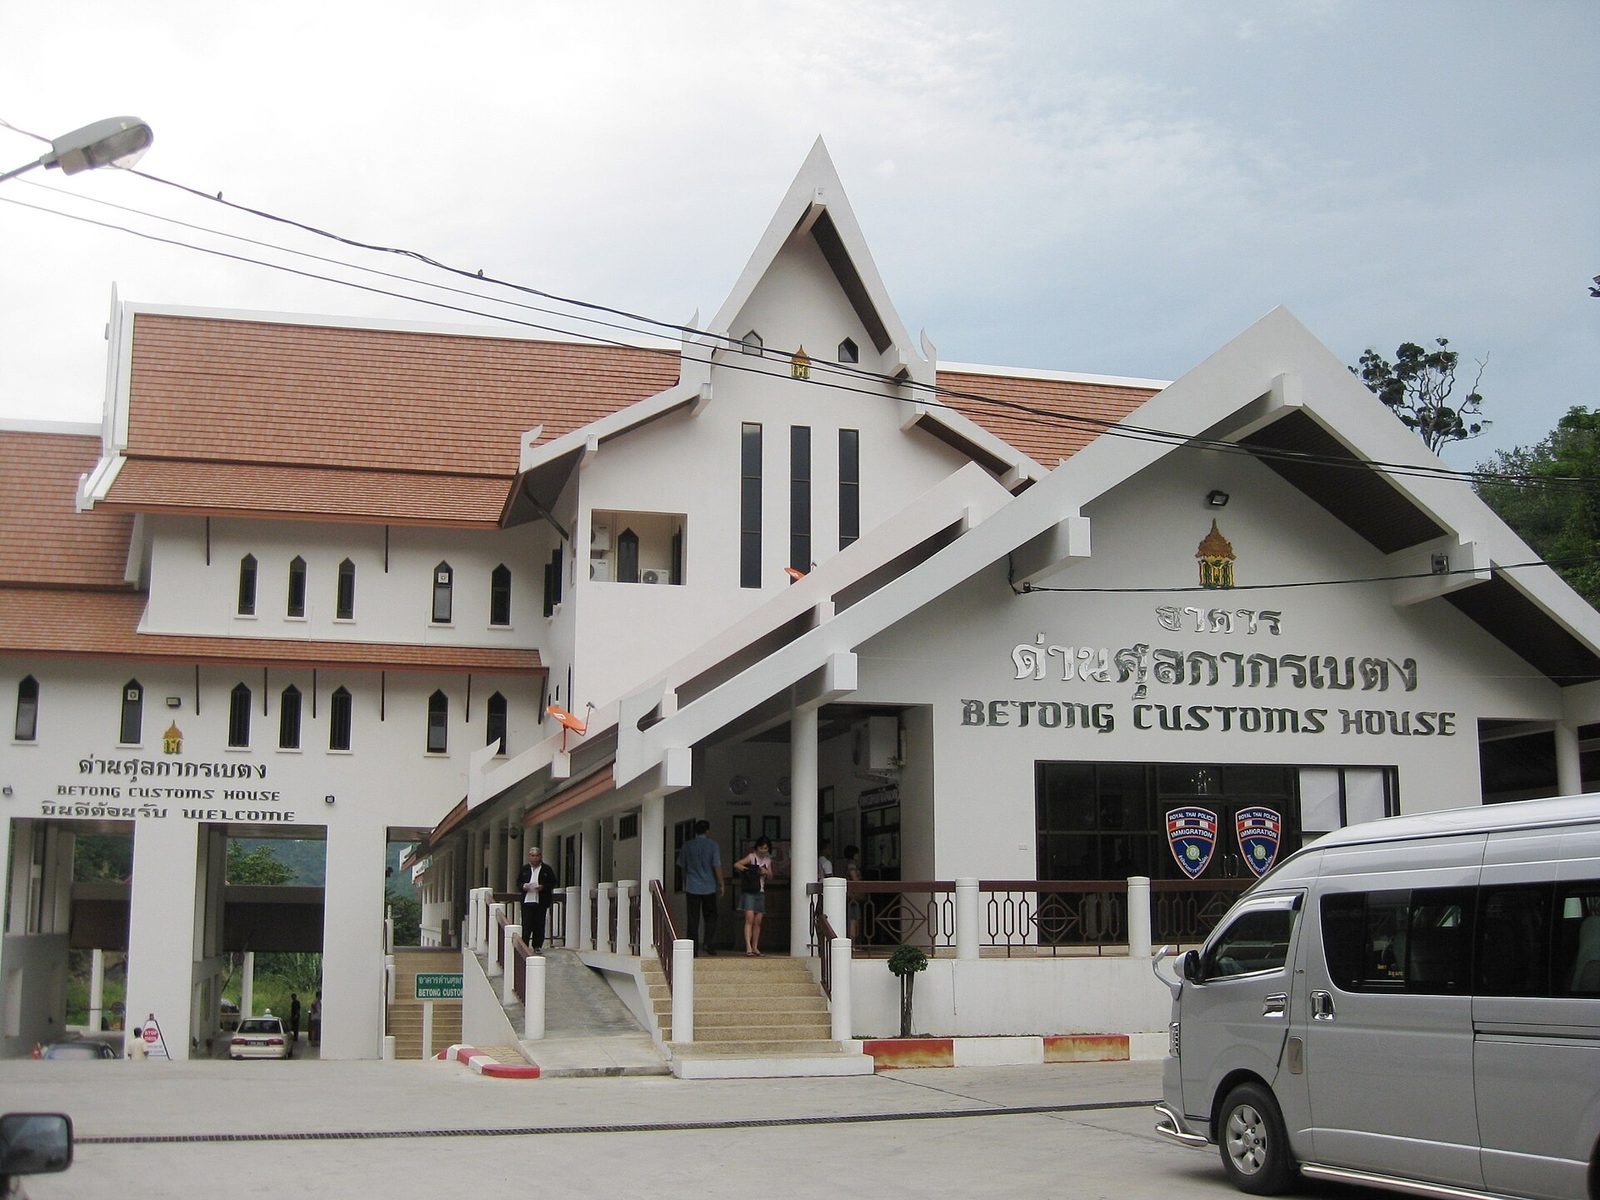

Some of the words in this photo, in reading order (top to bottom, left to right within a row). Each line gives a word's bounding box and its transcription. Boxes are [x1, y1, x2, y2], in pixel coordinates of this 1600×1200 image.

[1155, 605, 1282, 636] อาคาร
[1011, 631, 1418, 700] ด่านศุลกากรเบตง
[960, 698, 1115, 734] BETONG
[1132, 702, 1328, 735] CUSTOMS
[1338, 708, 1456, 737] HOUSE
[79, 753, 267, 783] ด่านศุลกากรเบตง
[57, 785, 121, 798] BETONG
[128, 787, 215, 800] CUSTOMS
[223, 790, 280, 802] HOUSE
[41, 800, 168, 819] ยินดีต้อนรับ
[181, 809, 295, 822] WELCOME
[1169, 812, 1184, 820] ROYAL
[1197, 812, 1214, 821] POLICE
[1238, 812, 1252, 820] ROYAL
[1263, 812, 1278, 821] POLICE
[1170, 828, 1213, 838] IMMIGRATION
[1240, 828, 1277, 838] IMMIGRATION
[419, 988, 441, 997] BETONG
